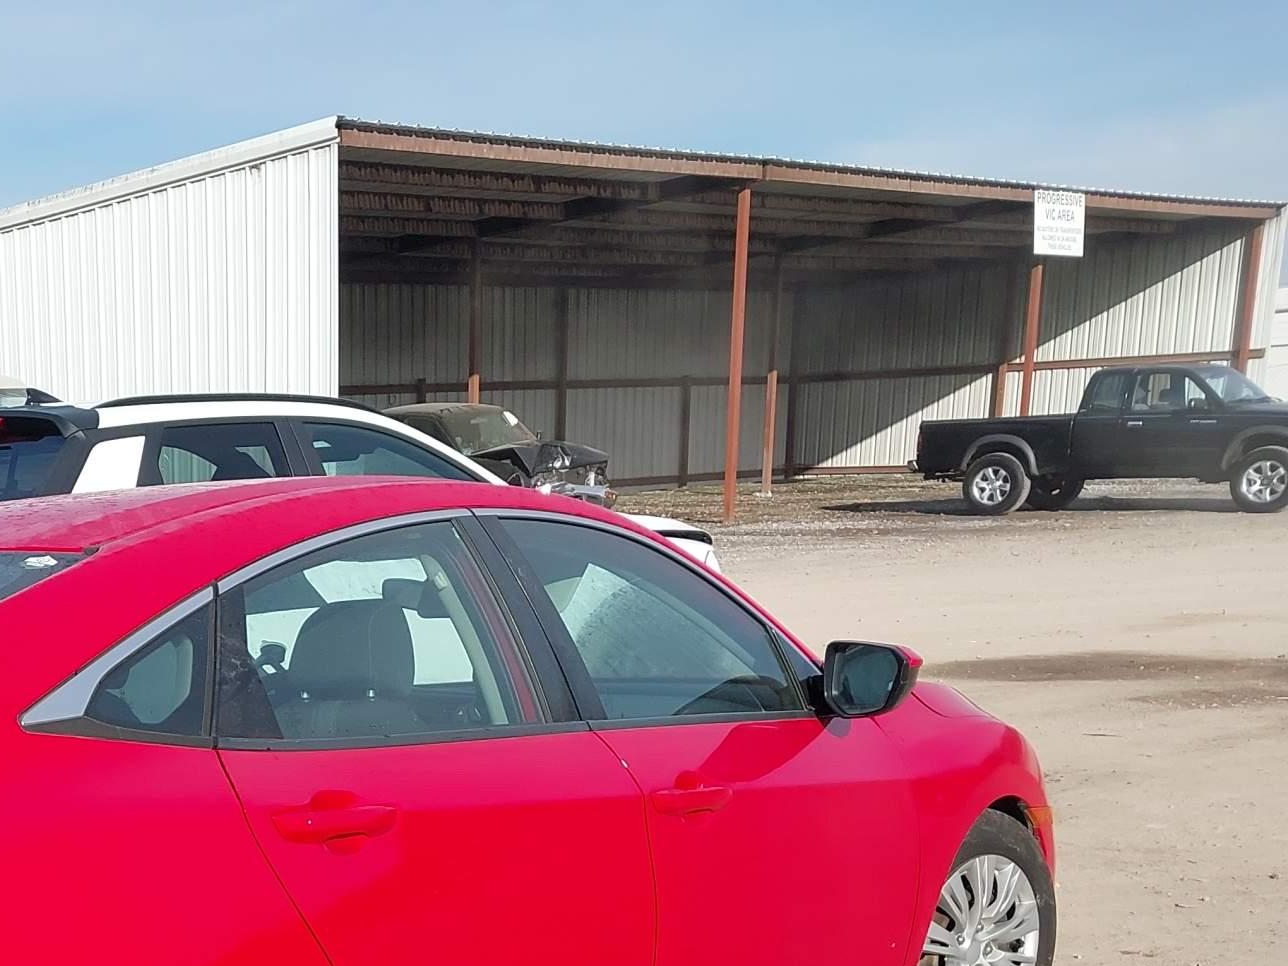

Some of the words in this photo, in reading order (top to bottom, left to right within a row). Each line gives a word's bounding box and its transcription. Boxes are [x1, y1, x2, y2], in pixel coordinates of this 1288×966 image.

[1037, 191, 1083, 207] PROGRESSIVE
[1045, 208, 1056, 221] VIC
[1057, 209, 1075, 222] AREA
